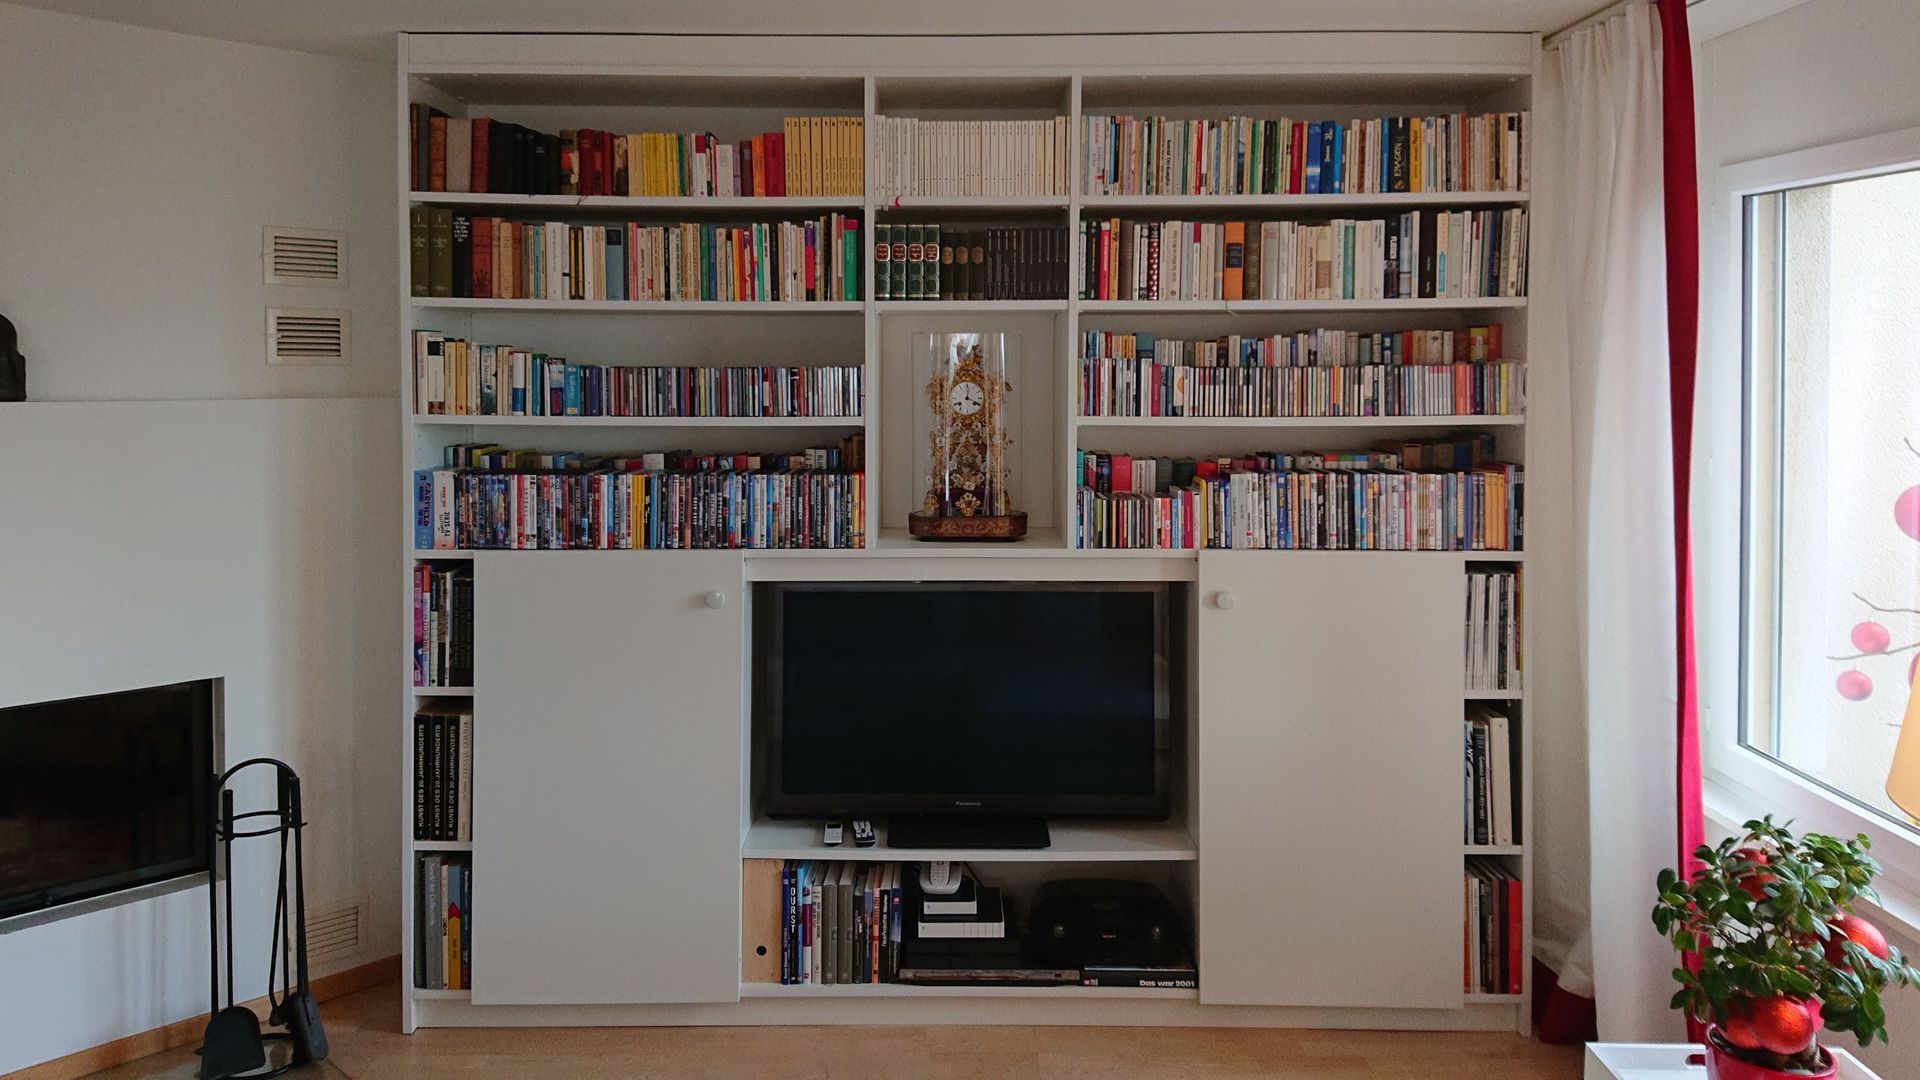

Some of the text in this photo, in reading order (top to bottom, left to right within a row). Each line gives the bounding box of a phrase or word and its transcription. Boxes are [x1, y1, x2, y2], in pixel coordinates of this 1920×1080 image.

[1393, 142, 1402, 177] ERAGON
[423, 482, 432, 527] GARFIELD
[417, 724, 425, 779] JAHRHUNDERTS
[417, 789, 425, 803] DES
[417, 805, 425, 827] KUNST
[1139, 979, 1156, 987] Das
[1175, 980, 1195, 988] 2001
